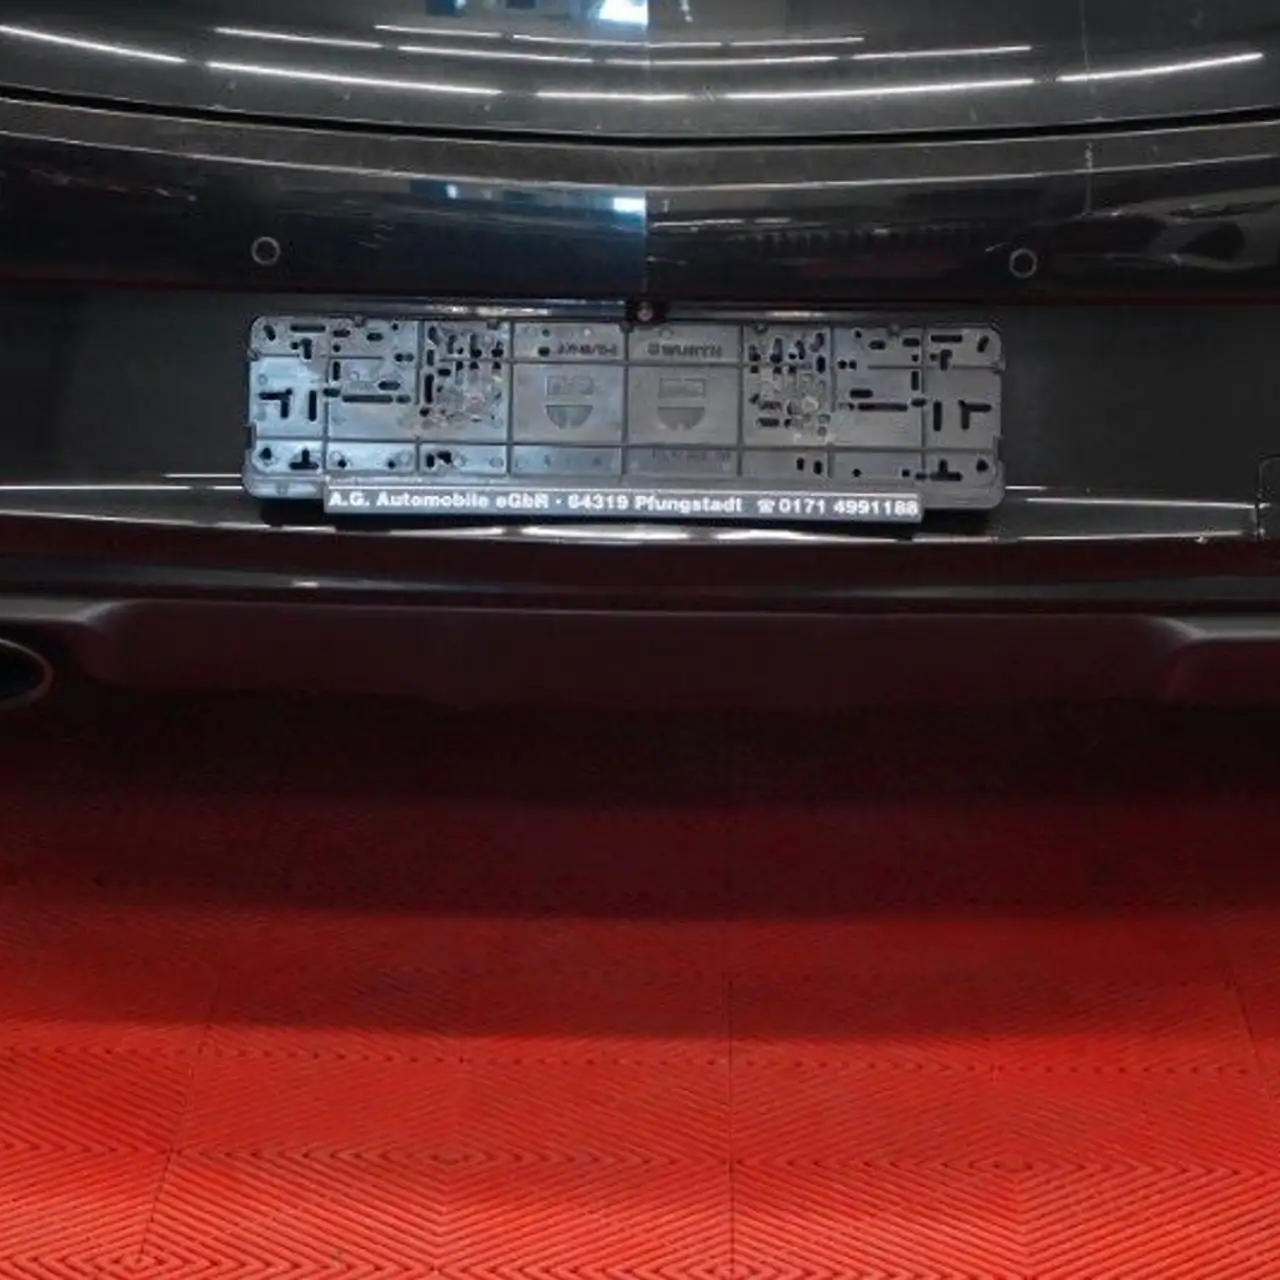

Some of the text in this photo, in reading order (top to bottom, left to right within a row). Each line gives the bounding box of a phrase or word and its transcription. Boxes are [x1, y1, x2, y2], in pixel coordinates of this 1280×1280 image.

[328, 491, 370, 507] A.G.
[376, 491, 489, 508] Automobile
[496, 493, 549, 509] eGbR
[568, 494, 628, 510] 64319
[634, 495, 742, 513] Pfungstadt
[779, 498, 825, 514] 0171
